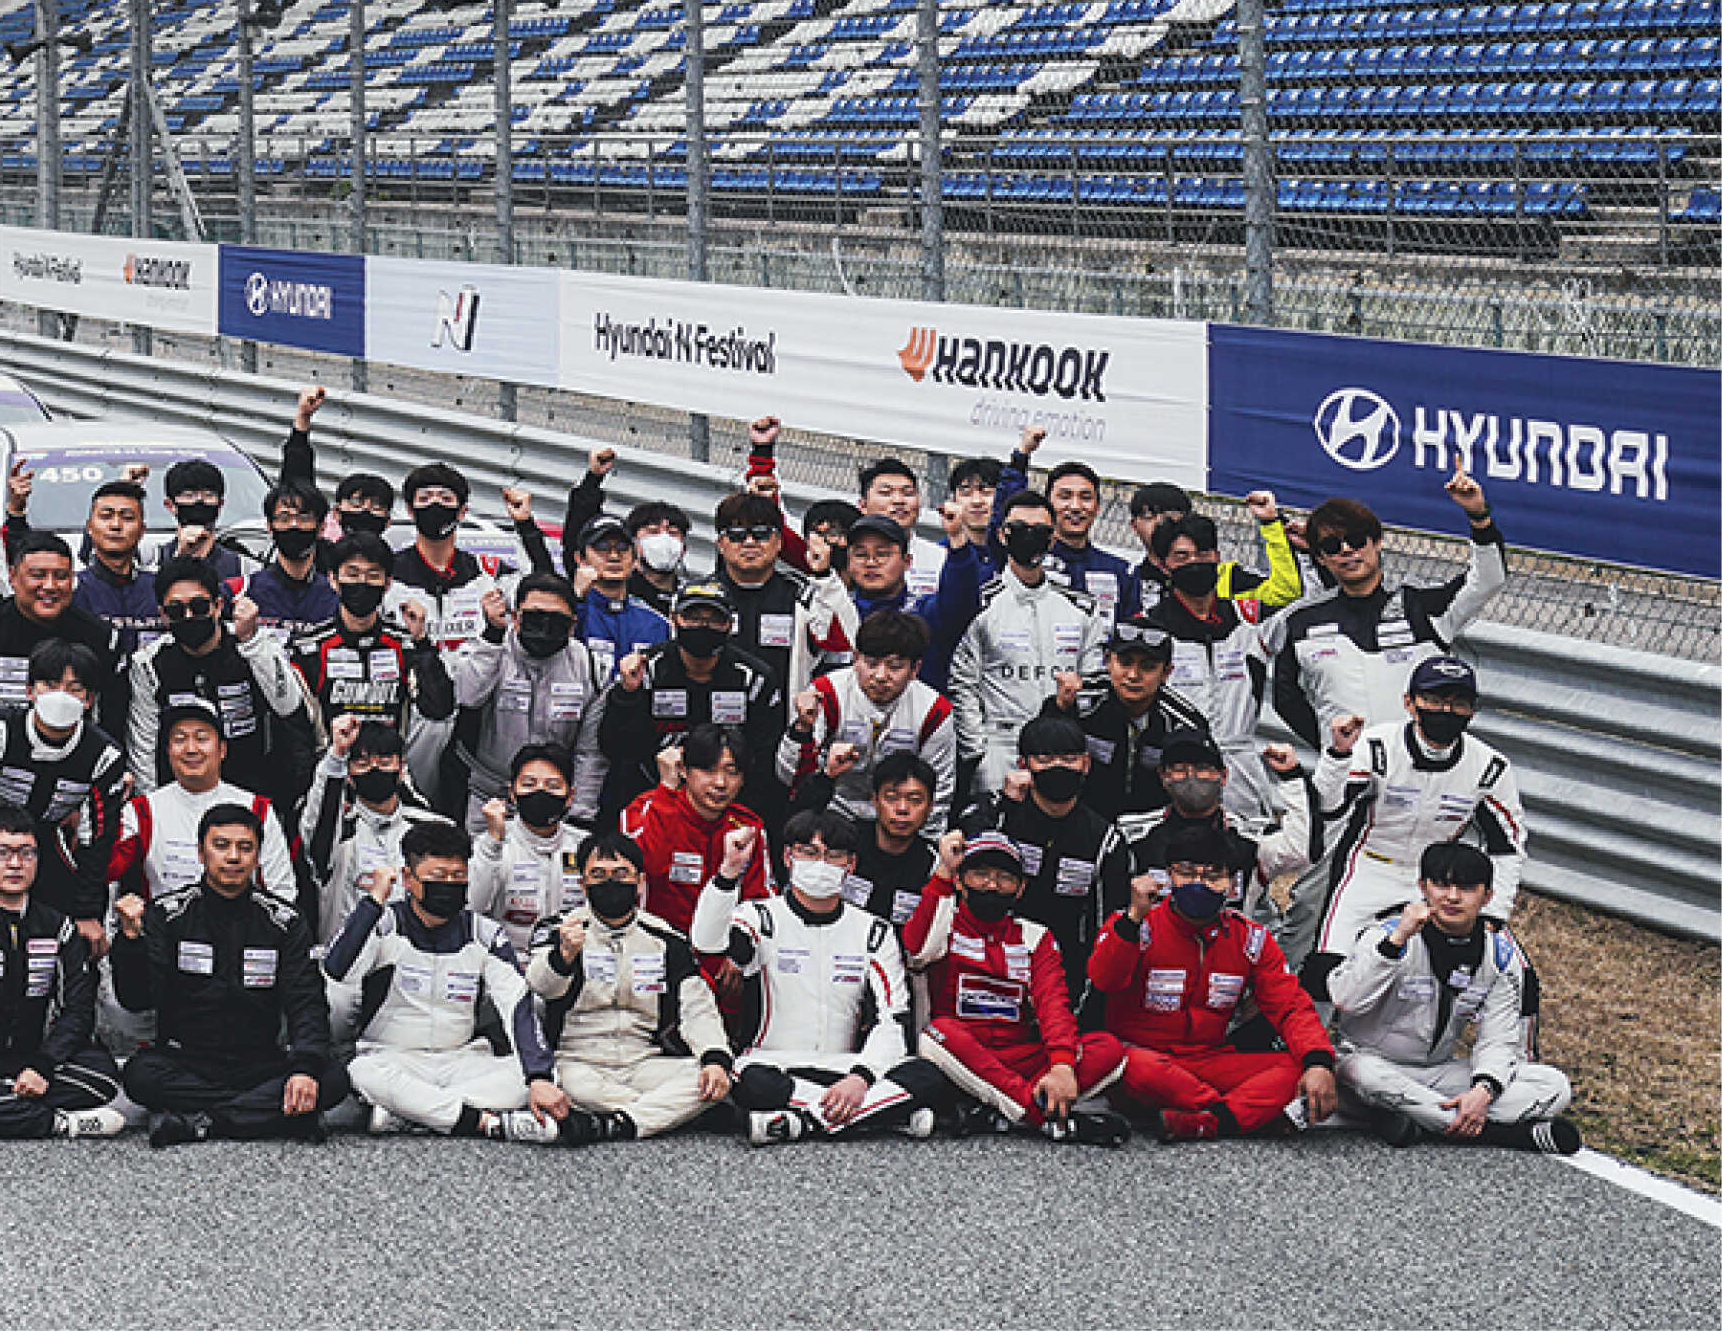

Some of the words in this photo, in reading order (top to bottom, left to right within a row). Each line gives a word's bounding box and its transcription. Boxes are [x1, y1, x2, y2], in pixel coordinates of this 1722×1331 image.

[594, 312, 673, 361] Hyundai
[676, 322, 693, 362] N
[695, 324, 776, 374] Festival
[39, 467, 104, 483] 450
[1412, 406, 1669, 500] HYUNDAI
